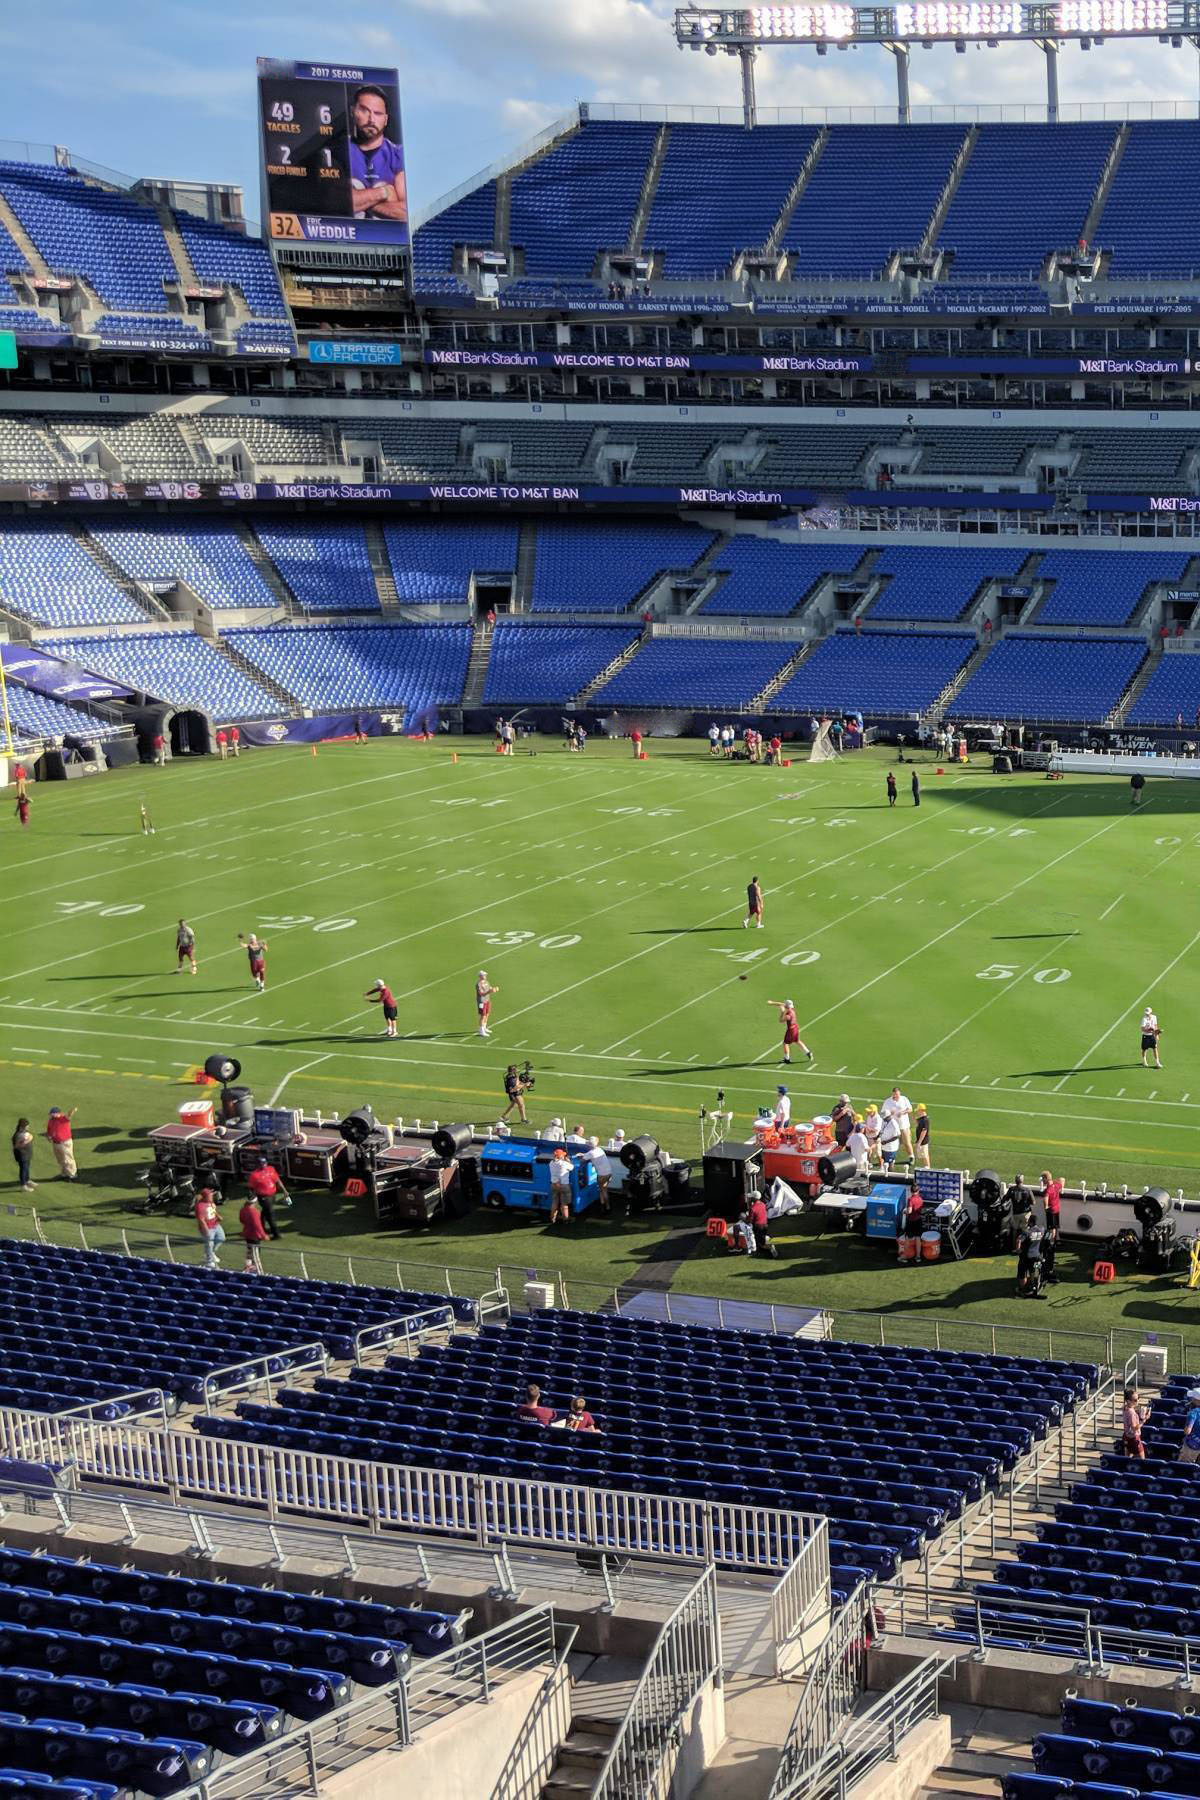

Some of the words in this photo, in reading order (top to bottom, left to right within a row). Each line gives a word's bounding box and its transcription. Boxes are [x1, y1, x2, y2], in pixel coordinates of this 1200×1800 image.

[311, 67, 331, 77] 2017
[332, 68, 364, 80] SEASON
[271, 101, 295, 122] 49
[320, 105, 332, 125] 6
[267, 121, 302, 134] TACKLES
[319, 125, 334, 136] INT
[280, 146, 292, 165] 2
[324, 149, 333, 167] 1
[319, 169, 341, 179] SACK
[275, 216, 294, 237] 32
[306, 217, 322, 226] ERIC
[307, 225, 357, 240] WEDDLE
[568, 302, 586, 310] RING
[599, 303, 625, 311] HONOR
[638, 303, 668, 311] EARNEST
[865, 305, 893, 313] ARTHUR
[903, 305, 930, 313] MODELL
[946, 305, 977, 313] MICHAEL
[1094, 305, 1114, 313] PETER
[1114, 305, 1154, 313] BOULWARE
[101, 339, 117, 347] TEXT
[245, 345, 291, 354] RAVENS
[333, 343, 396, 354] STRATEGIC
[333, 353, 395, 363] FACTORY
[432, 350, 463, 363] M&T
[463, 352, 491, 364] Bank
[491, 353, 538, 366] Stadium
[553, 355, 616, 368] WELCOME
[617, 355, 634, 368] TO
[637, 355, 664, 368] M&T
[665, 355, 691, 368] BAN
[763, 357, 790, 369] M&T
[790, 358, 815, 369] Bank
[816, 358, 859, 370] Stadium
[1079, 359, 1109, 372] M&T
[1108, 360, 1134, 372] Bank
[1135, 360, 1179, 372] Stadium
[275, 485, 307, 498] M&T
[308, 486, 338, 498] Bank
[339, 485, 392, 498] Stadium
[430, 487, 498, 499] WELCOME
[500, 487, 520, 499] TO
[522, 487, 550, 499] M&T
[553, 487, 579, 499] BAN
[680, 489, 709, 502] M&T
[708, 490, 736, 502] Bank
[736, 491, 782, 503] Stadium
[1150, 498, 1179, 511] M&T
[58, 901, 147, 918] 10
[259, 915, 358, 933] 20
[486, 930, 583, 949] 30
[727, 947, 822, 967] 40
[975, 963, 1073, 985] 50
[349, 1181, 361, 1195] 40
[708, 1220, 724, 1236] 50
[1096, 1265, 1111, 1280] 40
